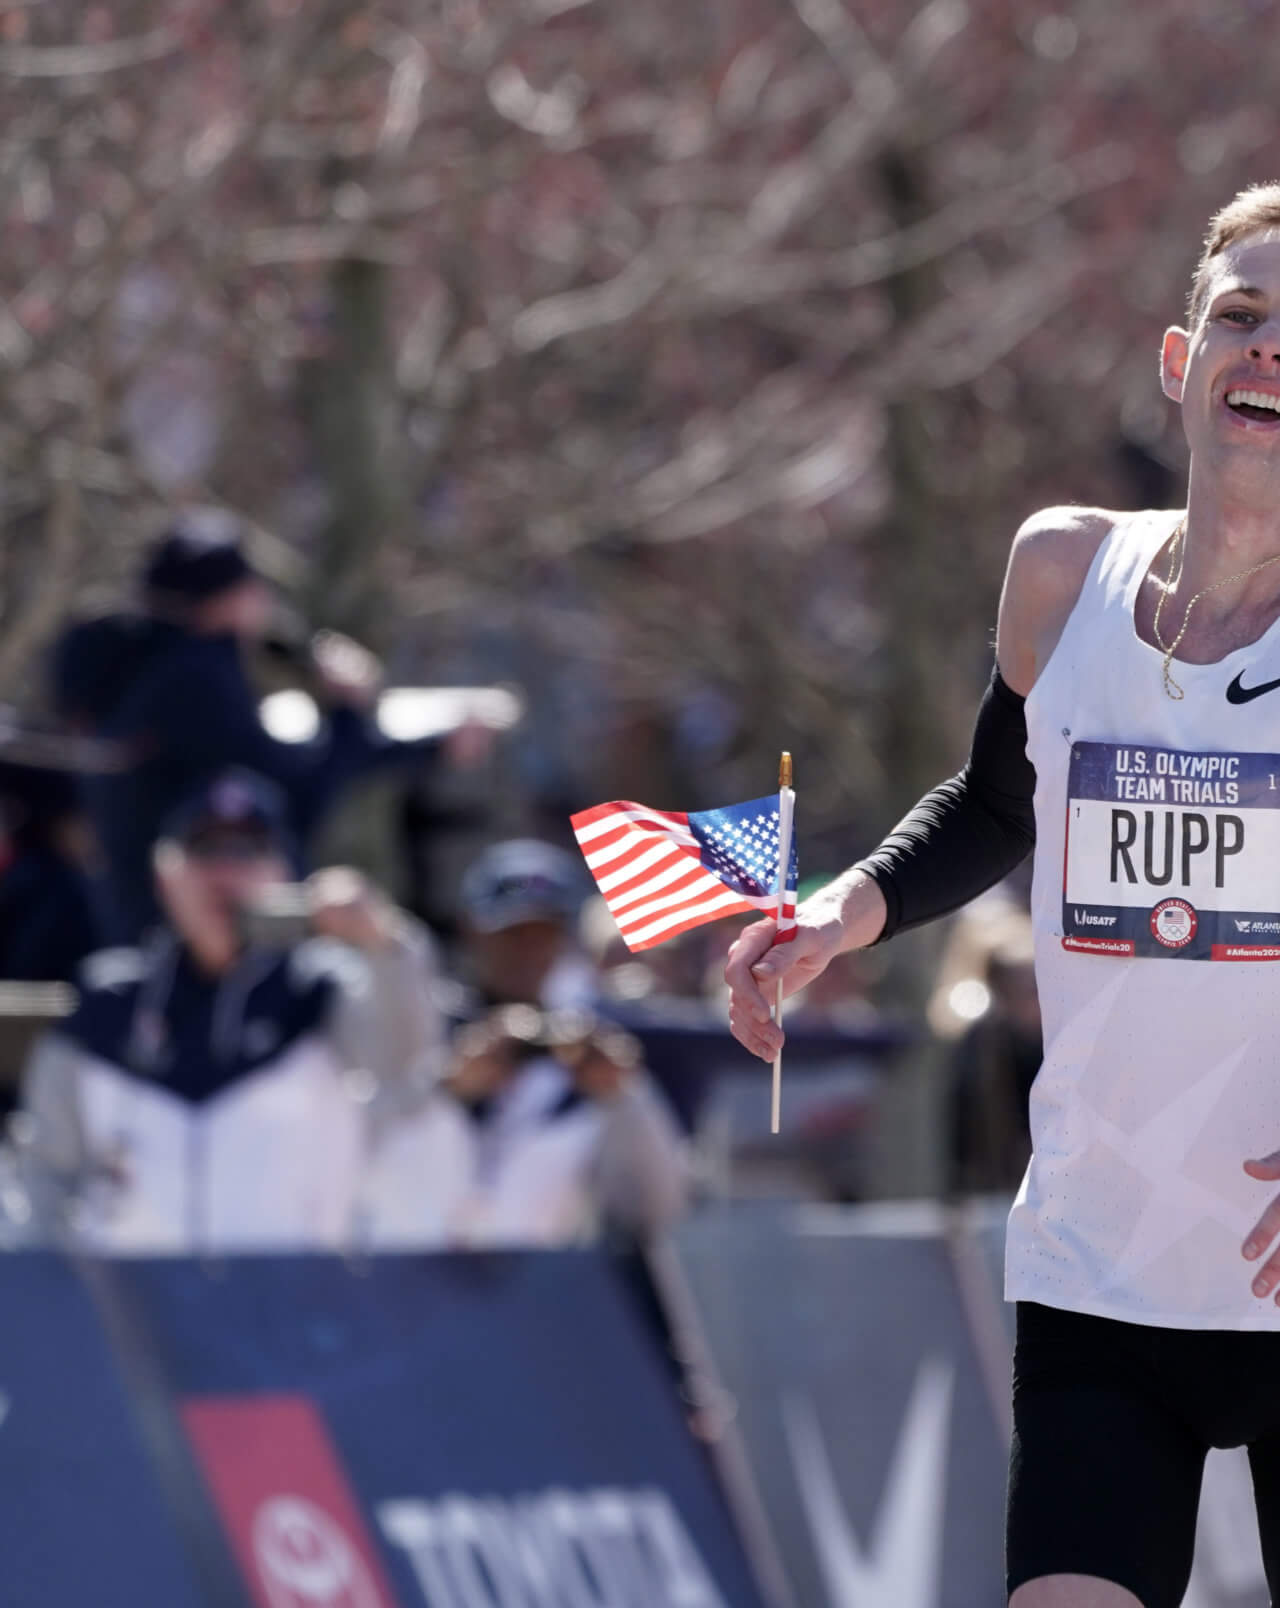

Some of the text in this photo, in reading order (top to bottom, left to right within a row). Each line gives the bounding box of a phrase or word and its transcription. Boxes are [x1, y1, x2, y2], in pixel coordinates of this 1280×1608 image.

[1115, 750, 1239, 779] U.S. OLYMPIC
[1115, 776, 1239, 804] TEAM TRIALS
[1268, 774, 1277, 790] 1
[1110, 809, 1245, 888] RUPP
[1086, 915, 1117, 926] USATF
